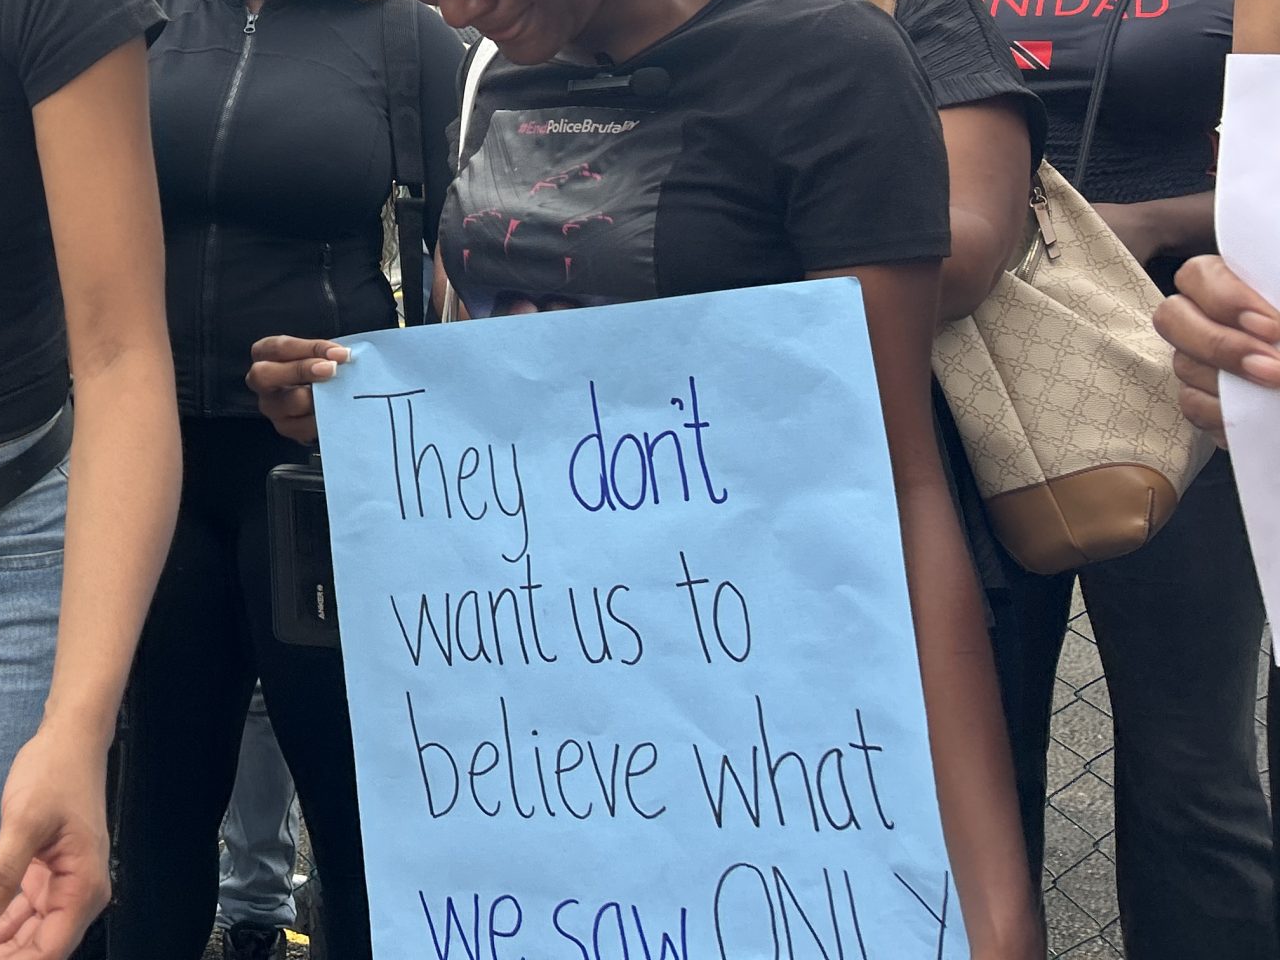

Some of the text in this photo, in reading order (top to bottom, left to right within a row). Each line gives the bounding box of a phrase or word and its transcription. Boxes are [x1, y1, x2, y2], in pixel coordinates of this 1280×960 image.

[353, 375, 728, 563] They don't
[390, 551, 751, 667] want us to
[406, 691, 895, 832] believe what
